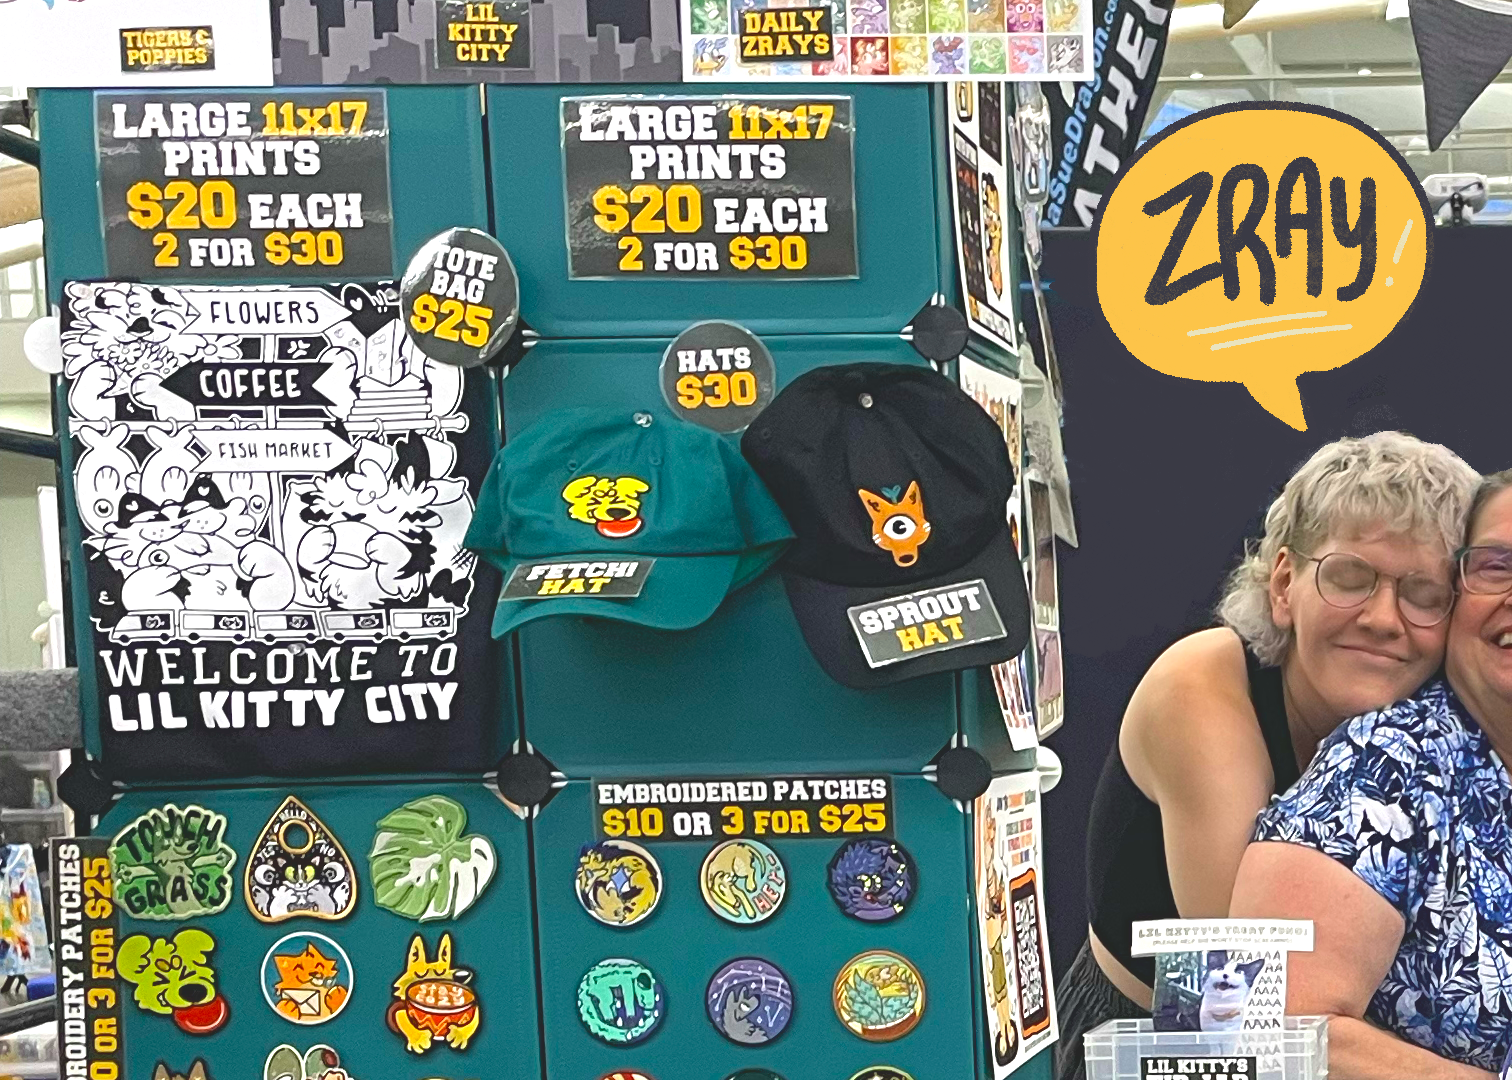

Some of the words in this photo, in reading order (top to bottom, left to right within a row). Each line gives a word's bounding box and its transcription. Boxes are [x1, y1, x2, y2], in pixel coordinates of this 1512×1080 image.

[466, 2, 499, 22] LIL
[745, 11, 825, 34] DAILY
[122, 30, 193, 48] TIGERS
[448, 23, 518, 43] KITTY
[743, 33, 831, 57] ZRAYS
[127, 47, 208, 66] POPPIES
[457, 43, 511, 63] CITY
[112, 102, 251, 138] LARGE
[261, 101, 368, 137] 11x17
[164, 141, 320, 177] PRINTS
[126, 180, 237, 230] $20
[248, 192, 364, 229] EACH
[433, 245, 498, 281] TOTE
[430, 271, 486, 303] BAG
[210, 299, 320, 325] FLOWERS
[410, 297, 494, 347] $25
[677, 347, 752, 374] HATS
[200, 368, 301, 399] COFFEE
[676, 372, 757, 409] $30
[218, 441, 258, 459] FISH
[266, 440, 333, 460] MARKET
[537, 578, 611, 595] HAT
[859, 587, 983, 634] SPROUT
[896, 618, 965, 653] HAT
[99, 646, 374, 688] WELCOME
[398, 642, 458, 679] TO
[108, 691, 188, 732] LIL
[201, 688, 343, 729] KITTY
[366, 682, 459, 723] CITY
[598, 781, 768, 803] EMBROIDERED
[774, 779, 887, 802] PATCHES
[115, 809, 224, 863] TOUCH
[257, 845, 275, 862] YES
[319, 844, 336, 857] NO
[57, 844, 83, 967] PATCHES
[125, 870, 227, 916] GRASS
[1147, 1059, 1174, 1074] LIL
[1177, 1058, 1248, 1074] KITTY'S
